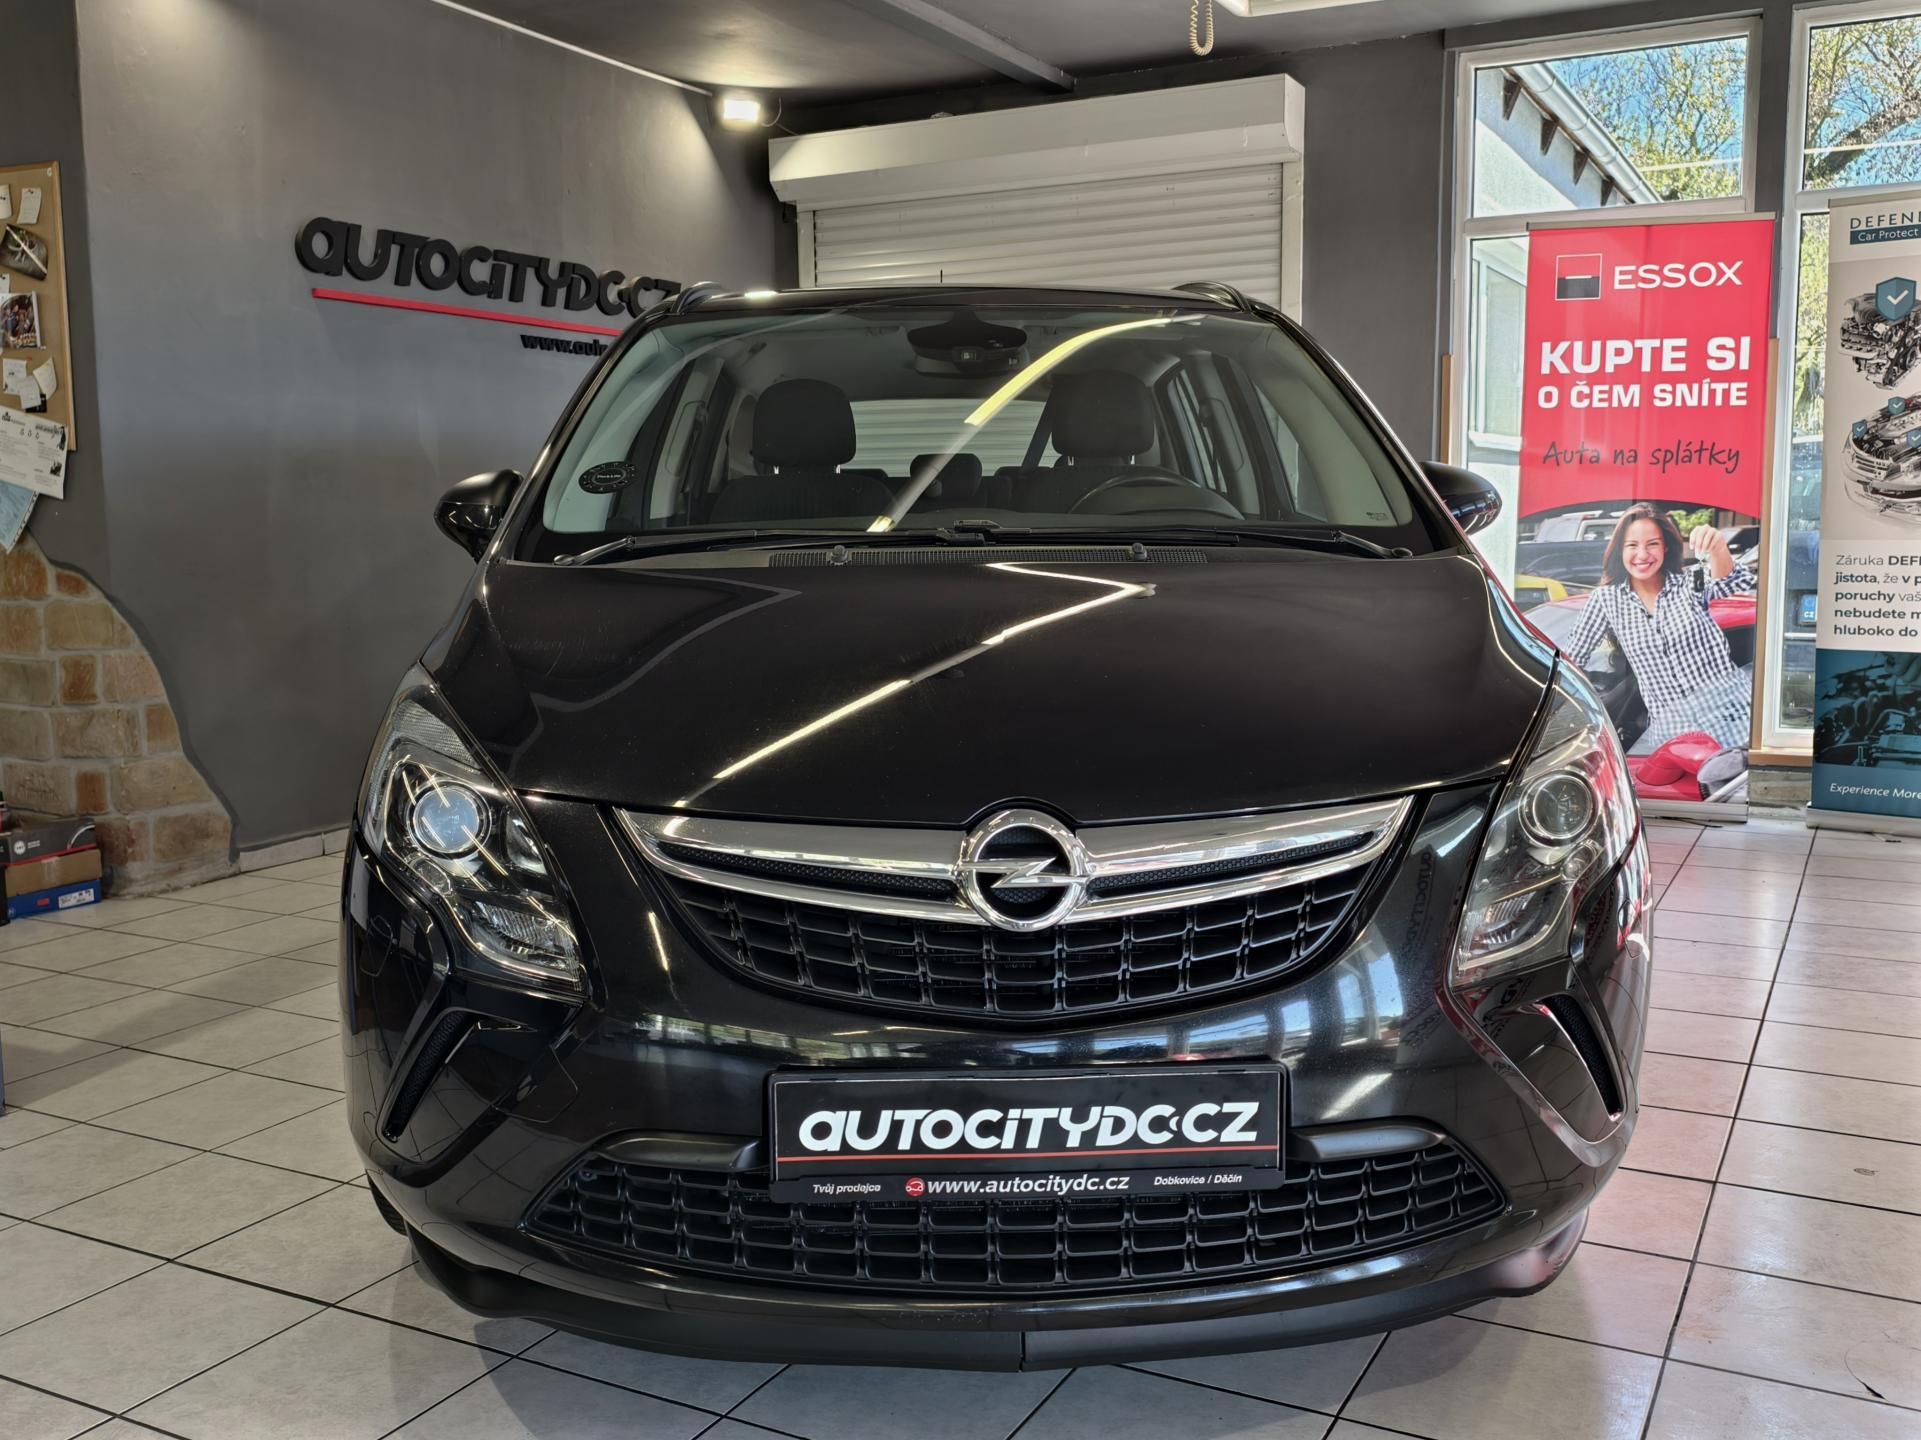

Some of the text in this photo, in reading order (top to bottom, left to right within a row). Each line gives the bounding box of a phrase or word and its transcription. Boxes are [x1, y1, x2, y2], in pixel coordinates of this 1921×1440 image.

[1850, 211, 1921, 229] DEFEN
[1858, 232, 1876, 241] Car
[1613, 261, 1743, 289] ESSOX
[1541, 336, 1751, 374] KUPTE SI
[1538, 378, 1748, 409] O ČEM SNÍTE
[1542, 440, 1740, 474] Auta na splátky
[1836, 555, 1921, 566] Záruka DEF
[1834, 572, 1880, 584] jistota,
[1883, 573, 1899, 584] že
[1835, 590, 1895, 603] poruchy
[1834, 608, 1906, 619] nebudete
[1834, 624, 1918, 637] hluboko do
[1830, 783, 1921, 800] Experience More
[927, 1174, 1130, 1196] www.autocitydc.cz
[1153, 1175, 1205, 1186] Dobkovice
[1214, 1173, 1243, 1184] Děčín
[812, 1183, 881, 1195] Tvůj prodejce
